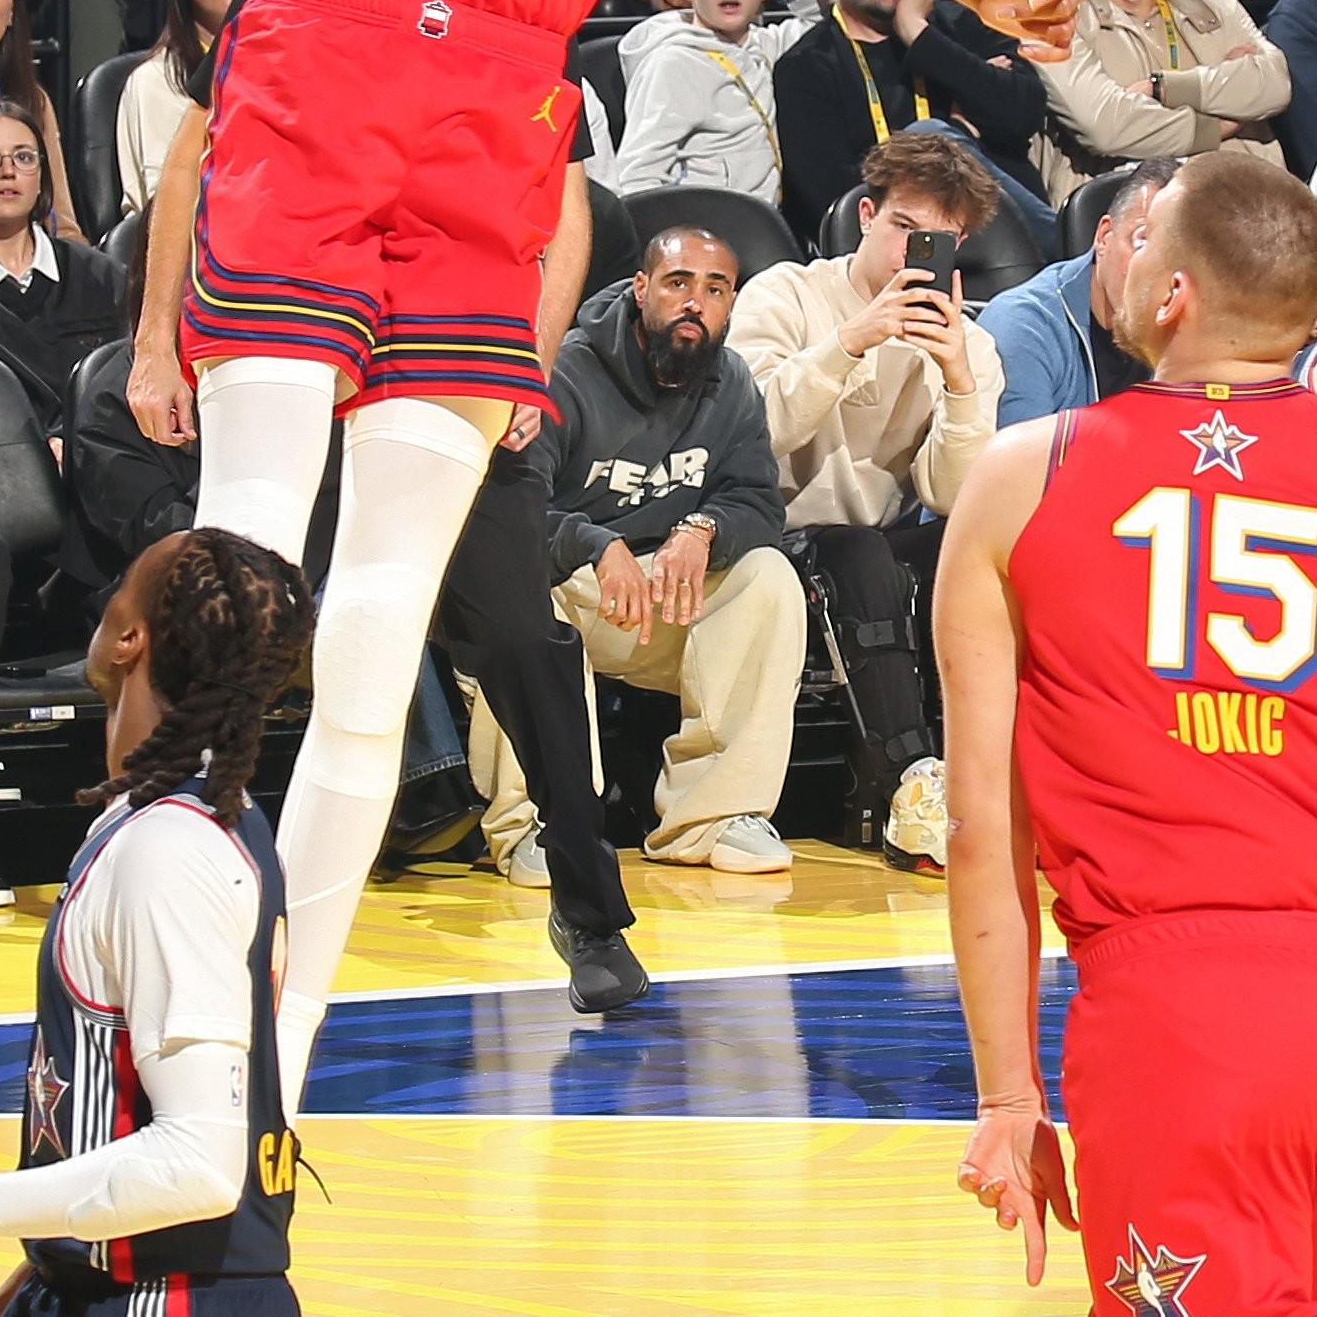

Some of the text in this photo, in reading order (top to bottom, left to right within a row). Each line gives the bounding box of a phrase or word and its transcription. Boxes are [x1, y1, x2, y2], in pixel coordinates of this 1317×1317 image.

[584, 447, 709, 494] FEAR
[1112, 486, 1317, 684] 15
[1167, 691, 1285, 756] JOKIC
